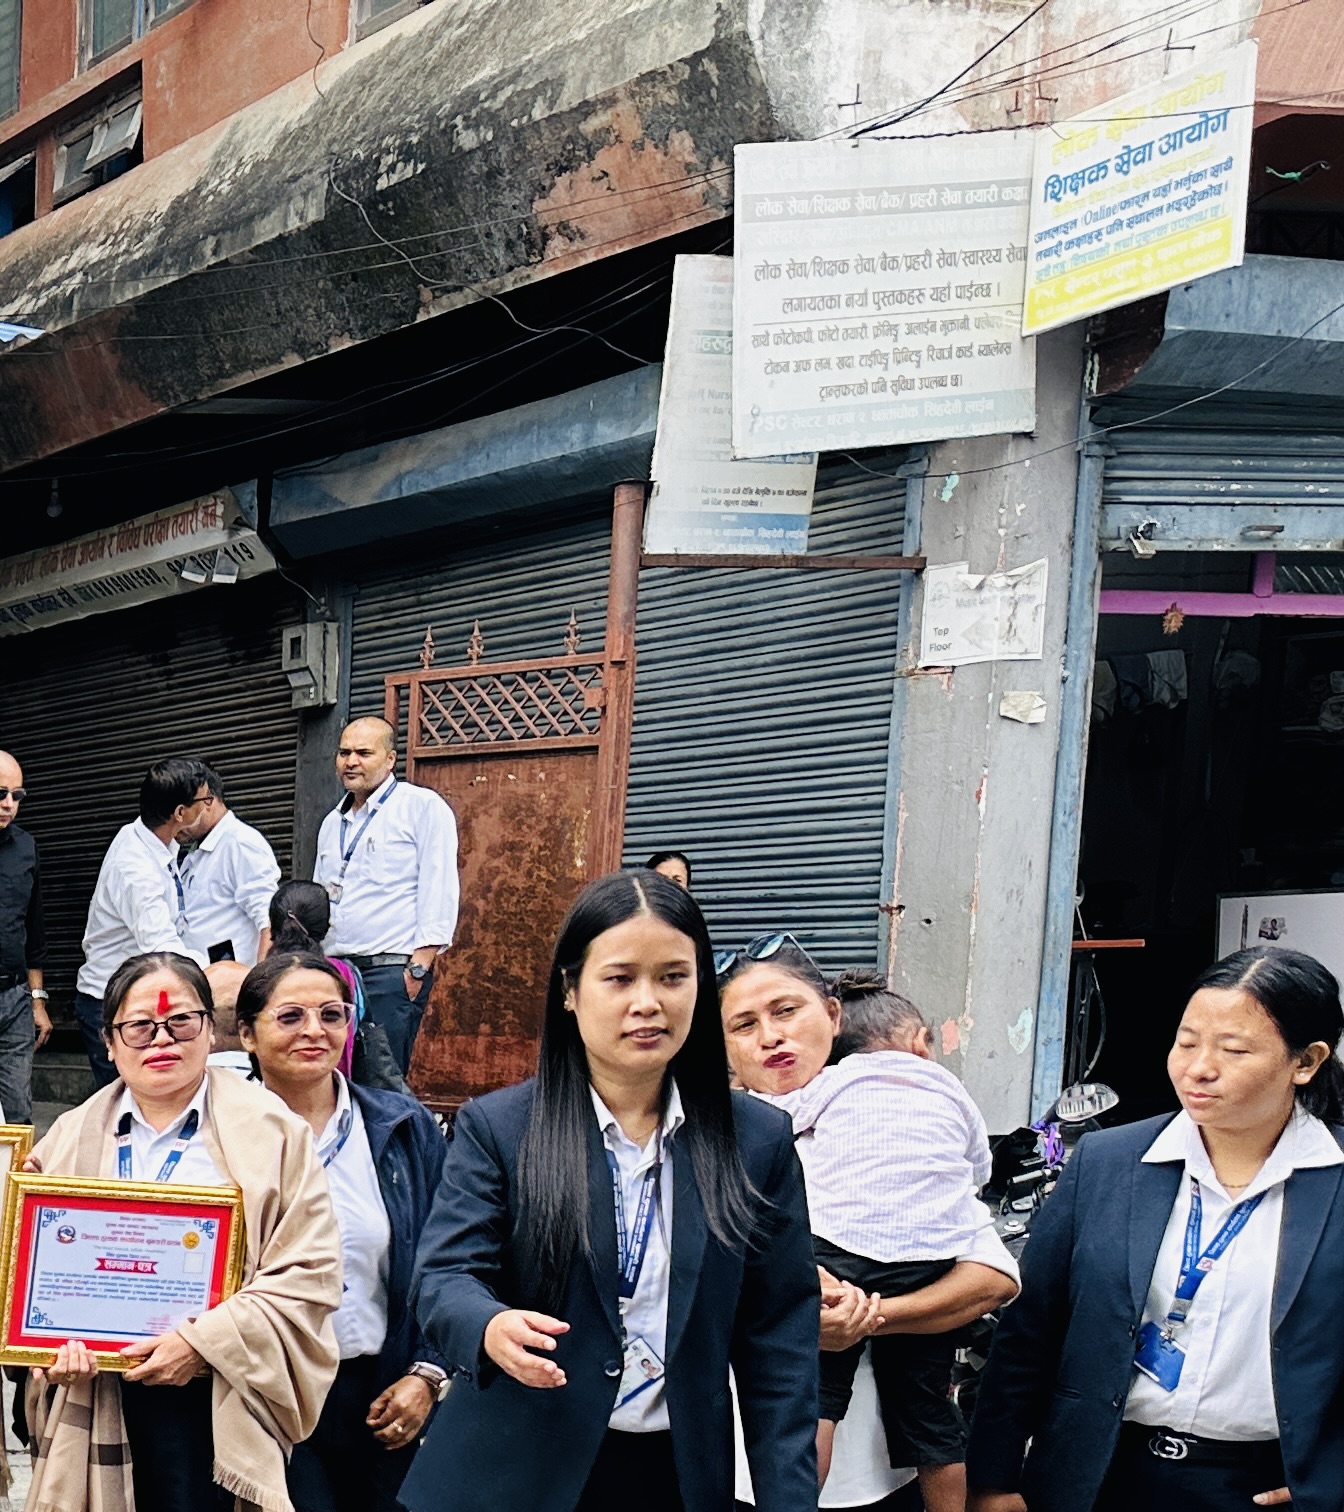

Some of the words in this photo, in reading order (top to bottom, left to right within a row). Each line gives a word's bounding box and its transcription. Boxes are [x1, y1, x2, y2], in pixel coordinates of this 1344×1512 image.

[1044, 158, 1112, 203] शिक्षक
[1115, 141, 1155, 176] सेवा
[1158, 109, 1231, 156] आयोग
[755, 197, 783, 217] लोक
[941, 186, 963, 206] सेवा
[754, 260, 781, 281] लोक
